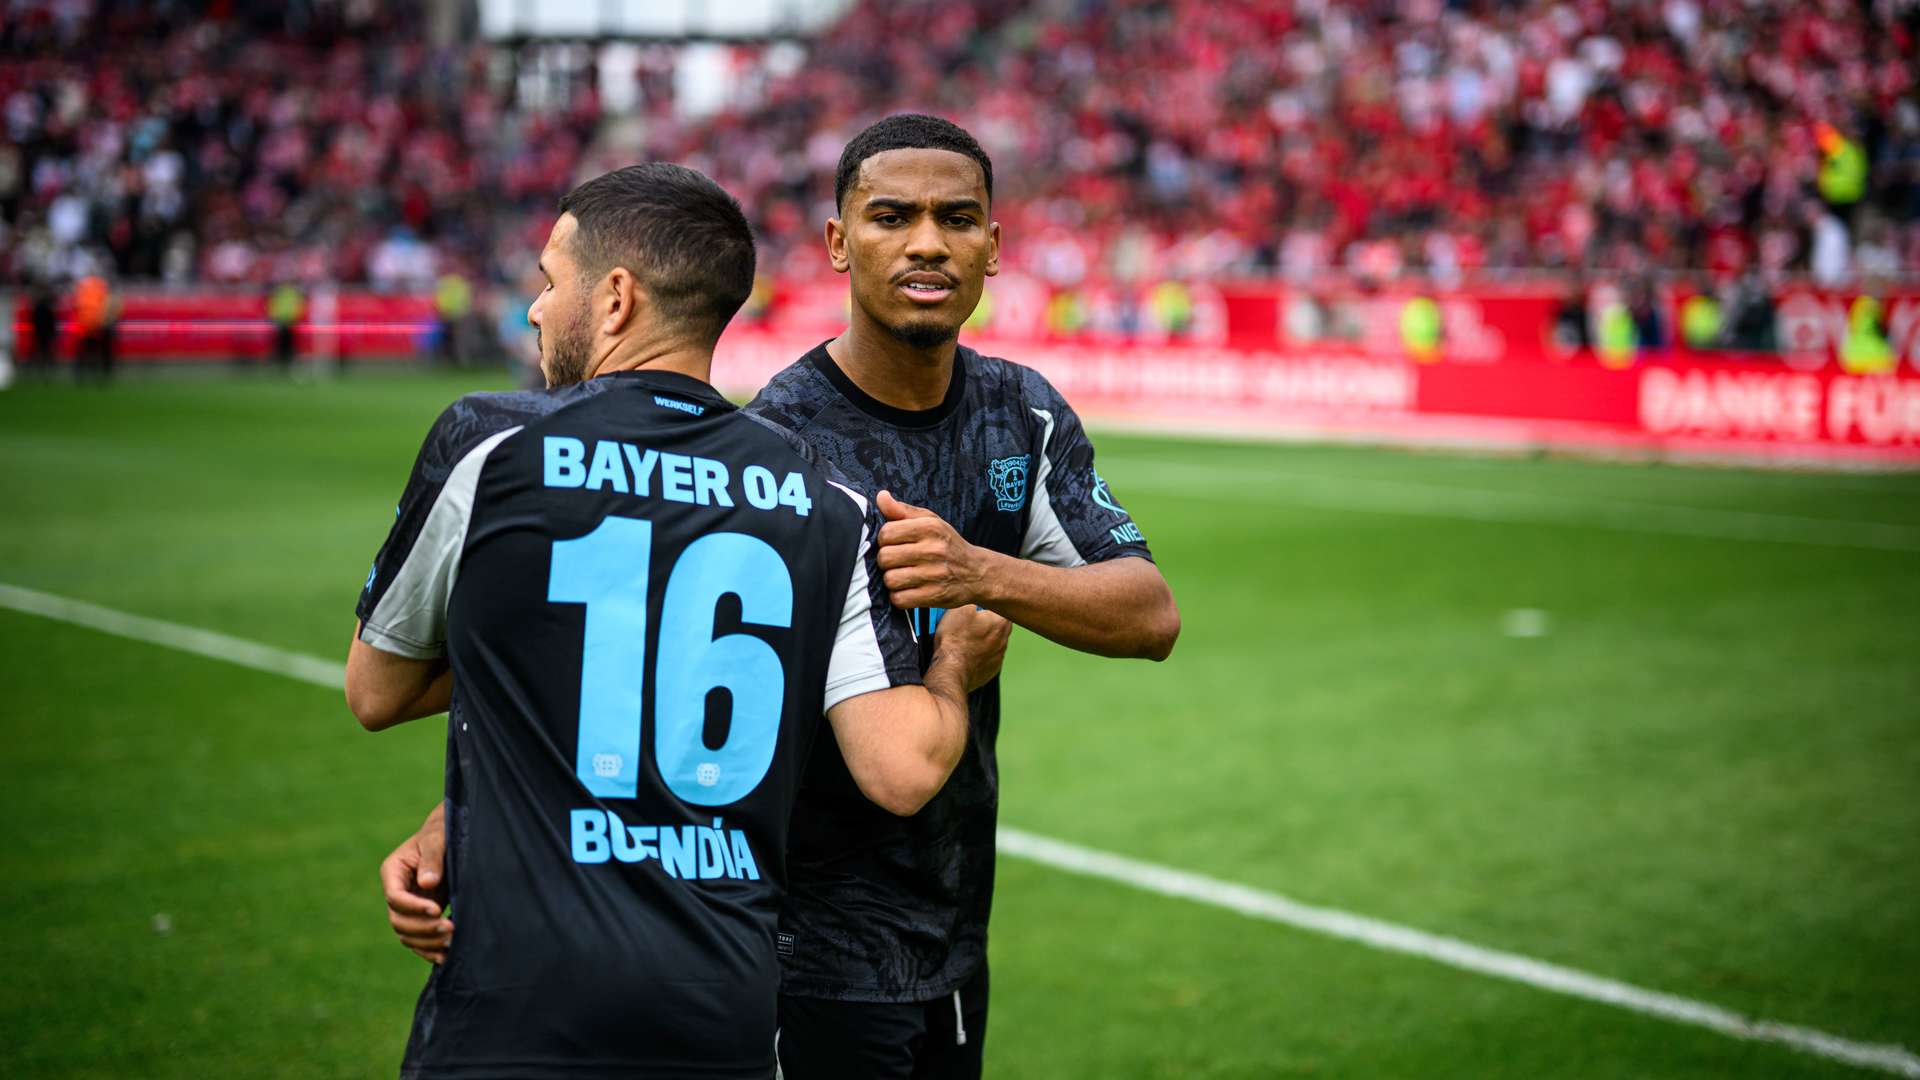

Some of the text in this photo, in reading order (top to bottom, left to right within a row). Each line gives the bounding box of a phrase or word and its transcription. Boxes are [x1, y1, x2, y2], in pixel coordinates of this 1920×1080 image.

[654, 396, 705, 416] WERKSELF
[544, 436, 812, 517] BAYER 04
[547, 515, 793, 807] 16
